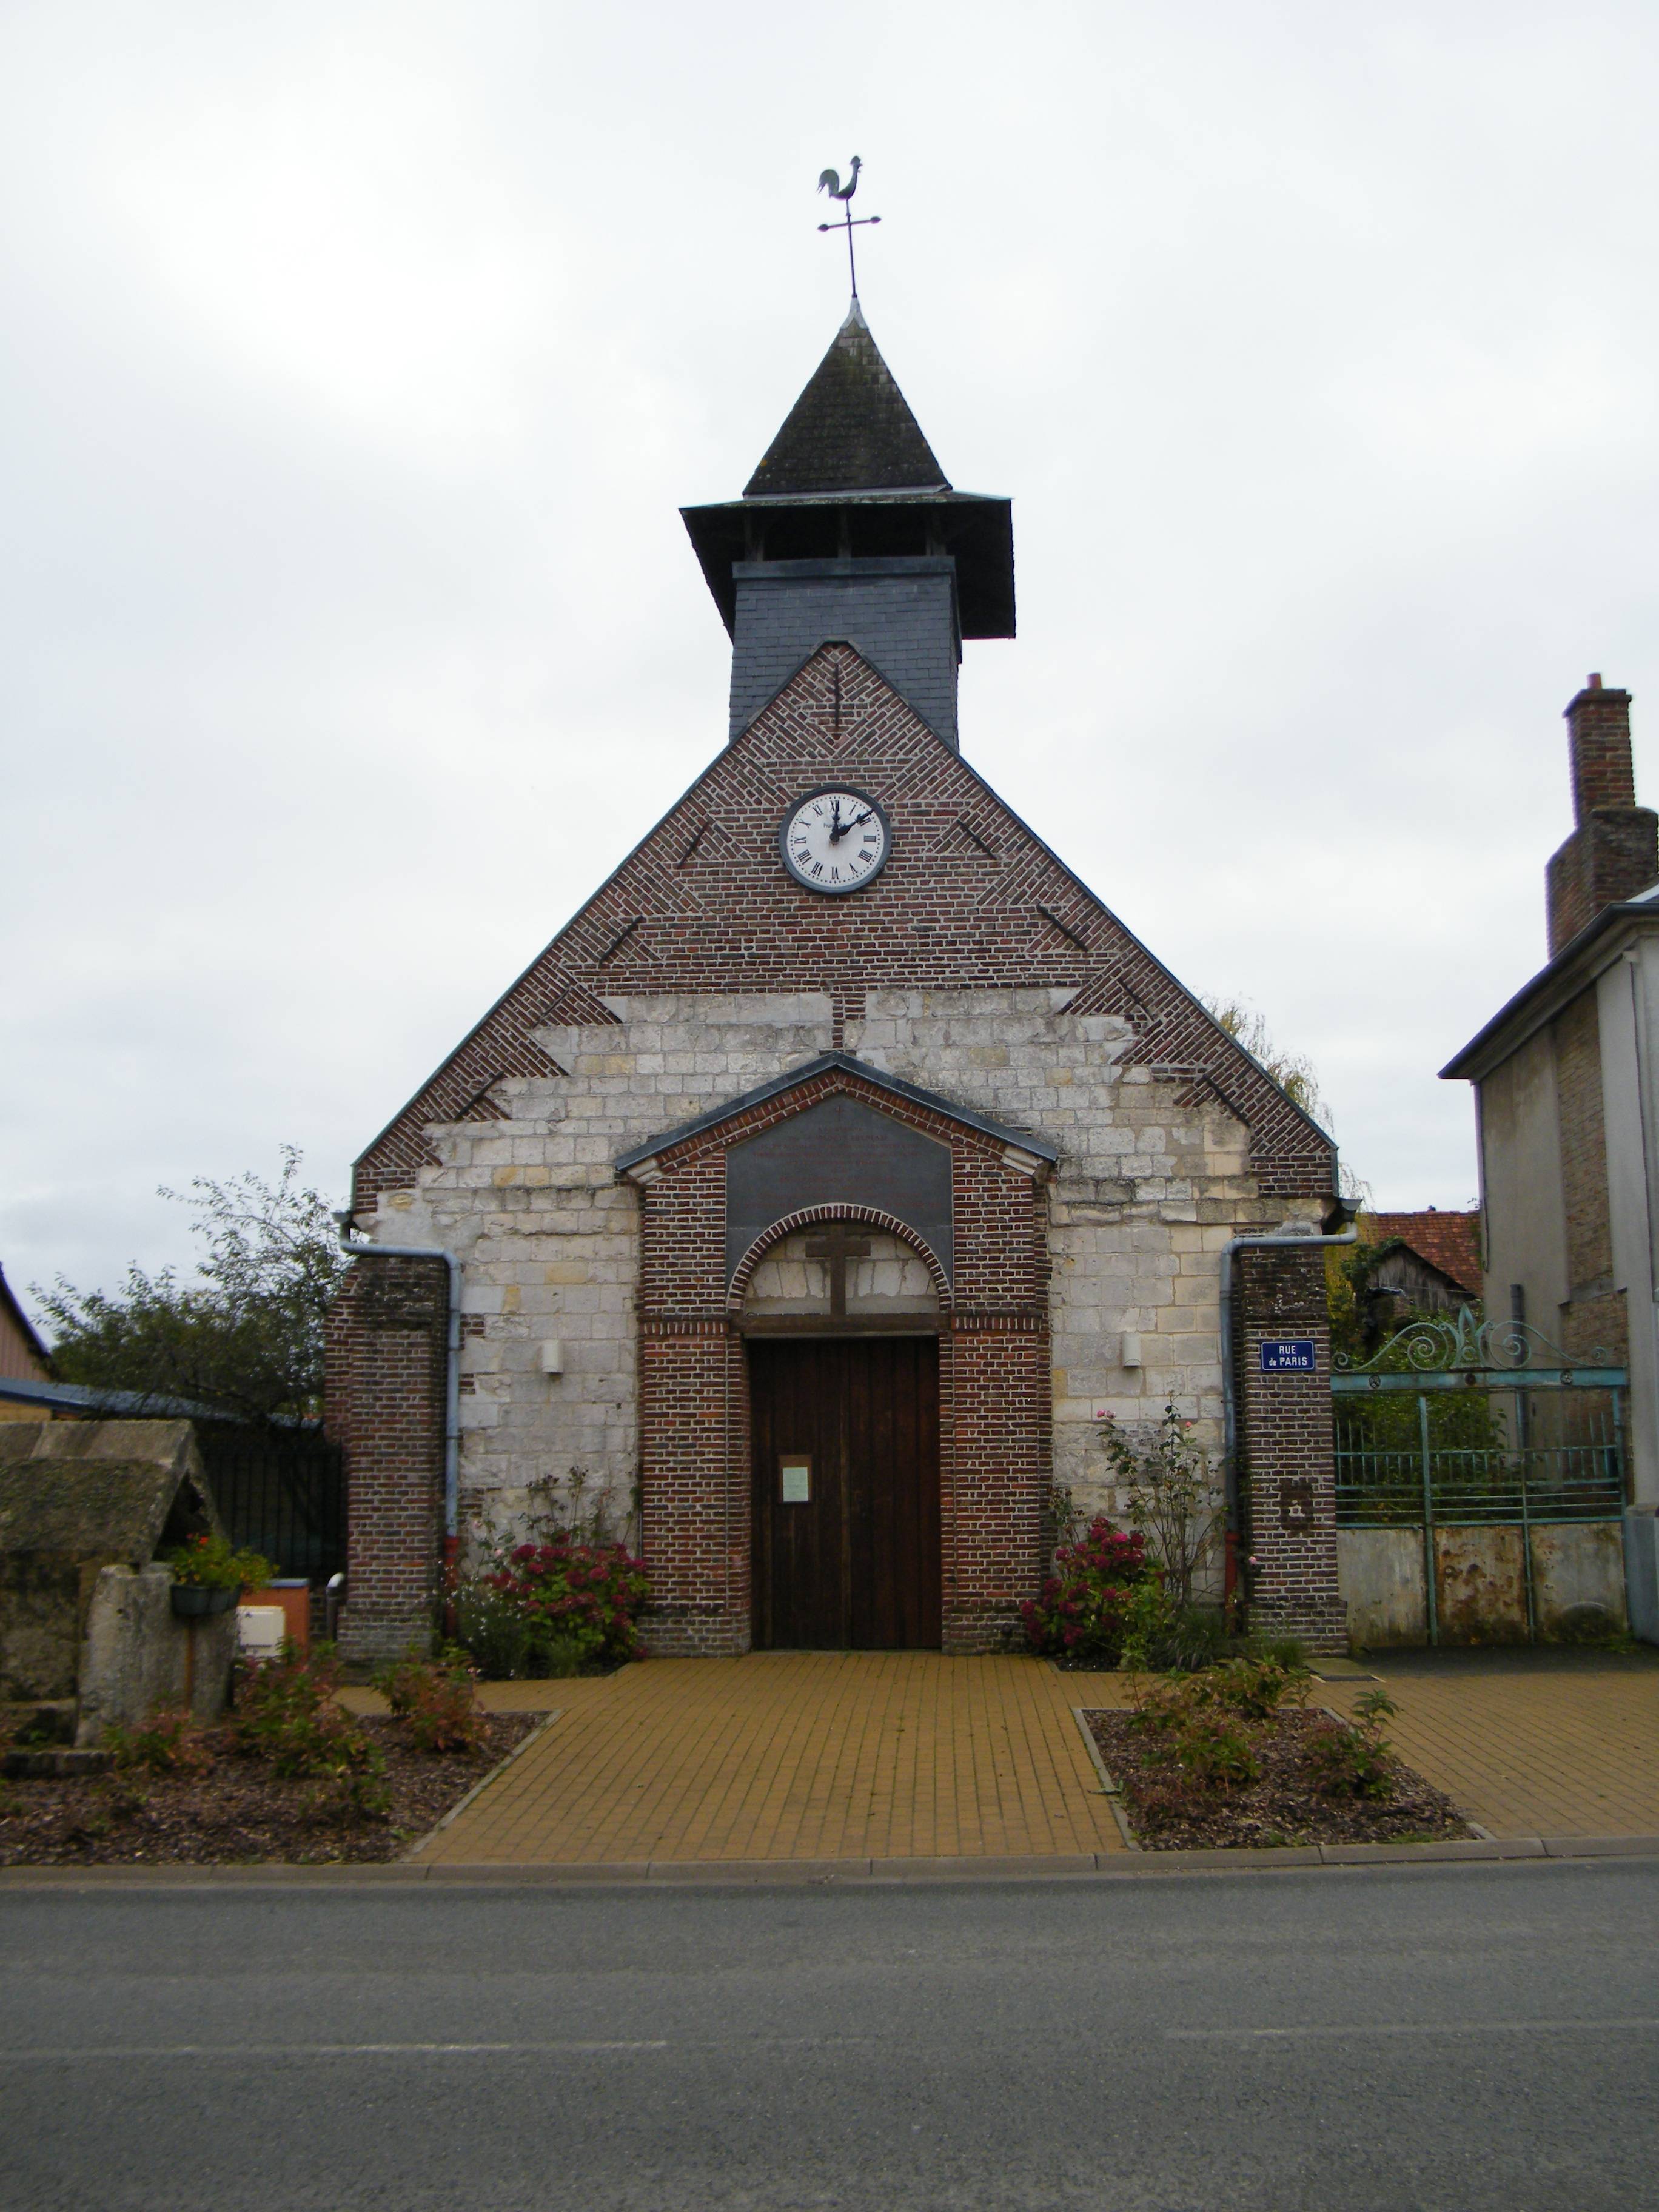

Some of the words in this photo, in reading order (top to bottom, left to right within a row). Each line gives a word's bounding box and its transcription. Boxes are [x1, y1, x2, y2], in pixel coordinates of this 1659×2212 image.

[798, 819, 811, 829] X
[1279, 1346, 1296, 1355] RUE
[1279, 1357, 1307, 1366] PARIS
